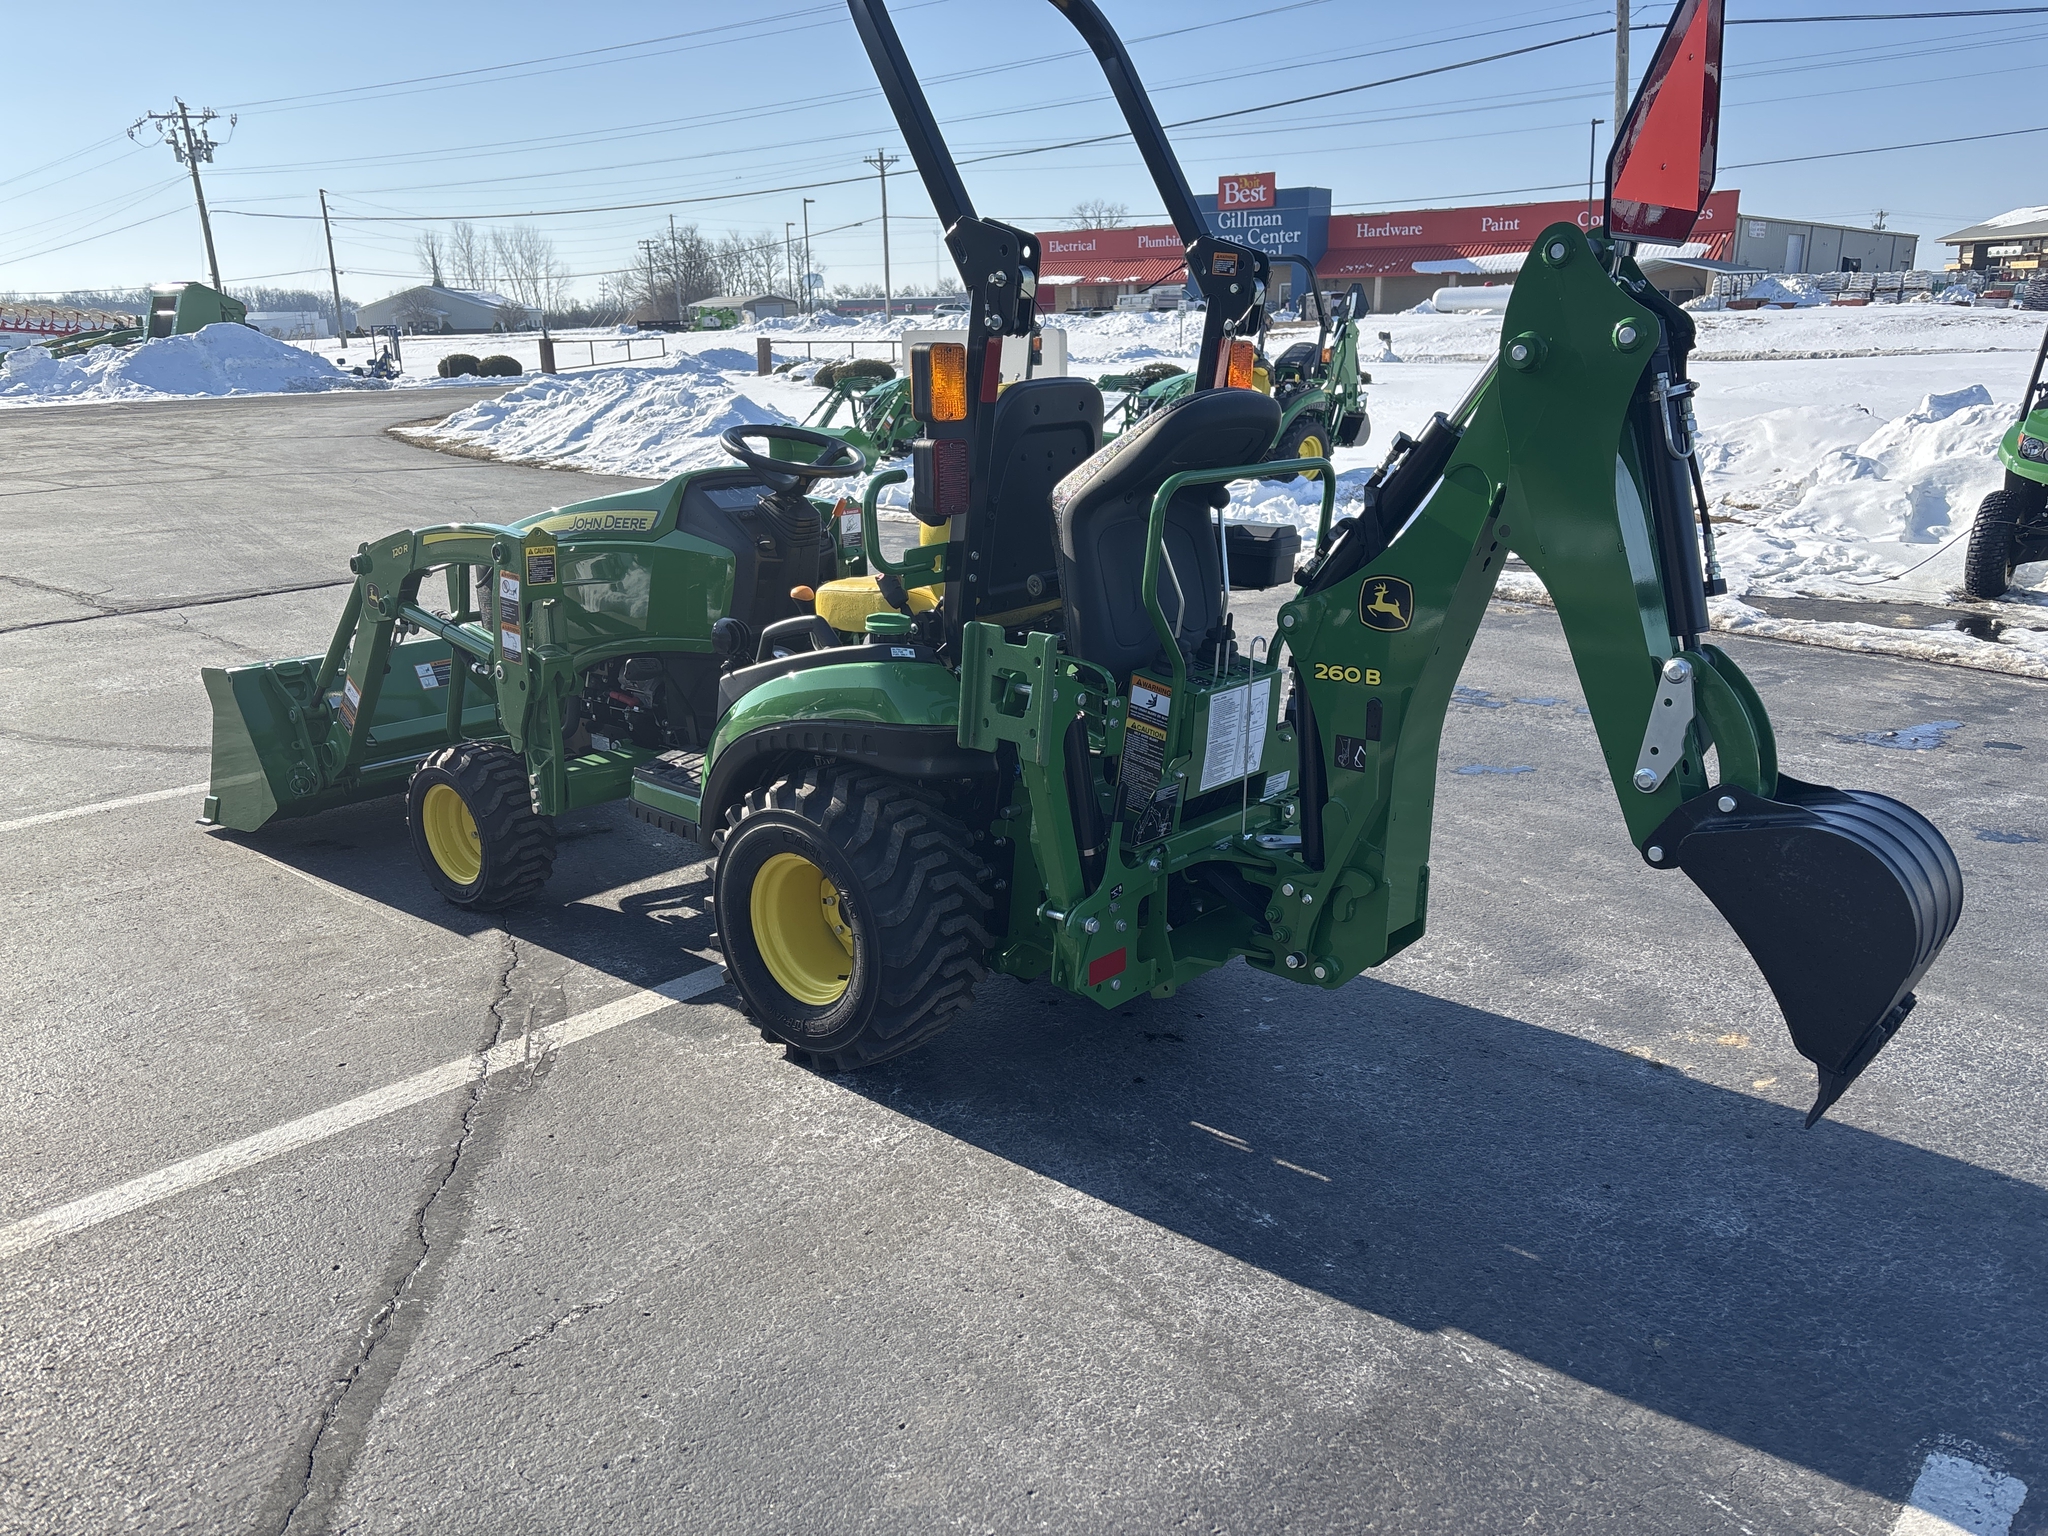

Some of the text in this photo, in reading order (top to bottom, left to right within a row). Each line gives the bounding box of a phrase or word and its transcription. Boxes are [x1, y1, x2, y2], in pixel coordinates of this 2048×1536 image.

[1223, 181, 1267, 205] Best
[1218, 211, 1283, 229] Gillman
[1481, 217, 1520, 232] Paint
[1247, 228, 1301, 245] Center
[1356, 222, 1423, 238] Hardware
[1048, 239, 1096, 253] Electrical
[1137, 235, 1184, 249] Plumbin
[568, 514, 648, 530] JOHN DEERE
[1142, 681, 1171, 697] WARNING
[1136, 724, 1165, 740] CAUTION
